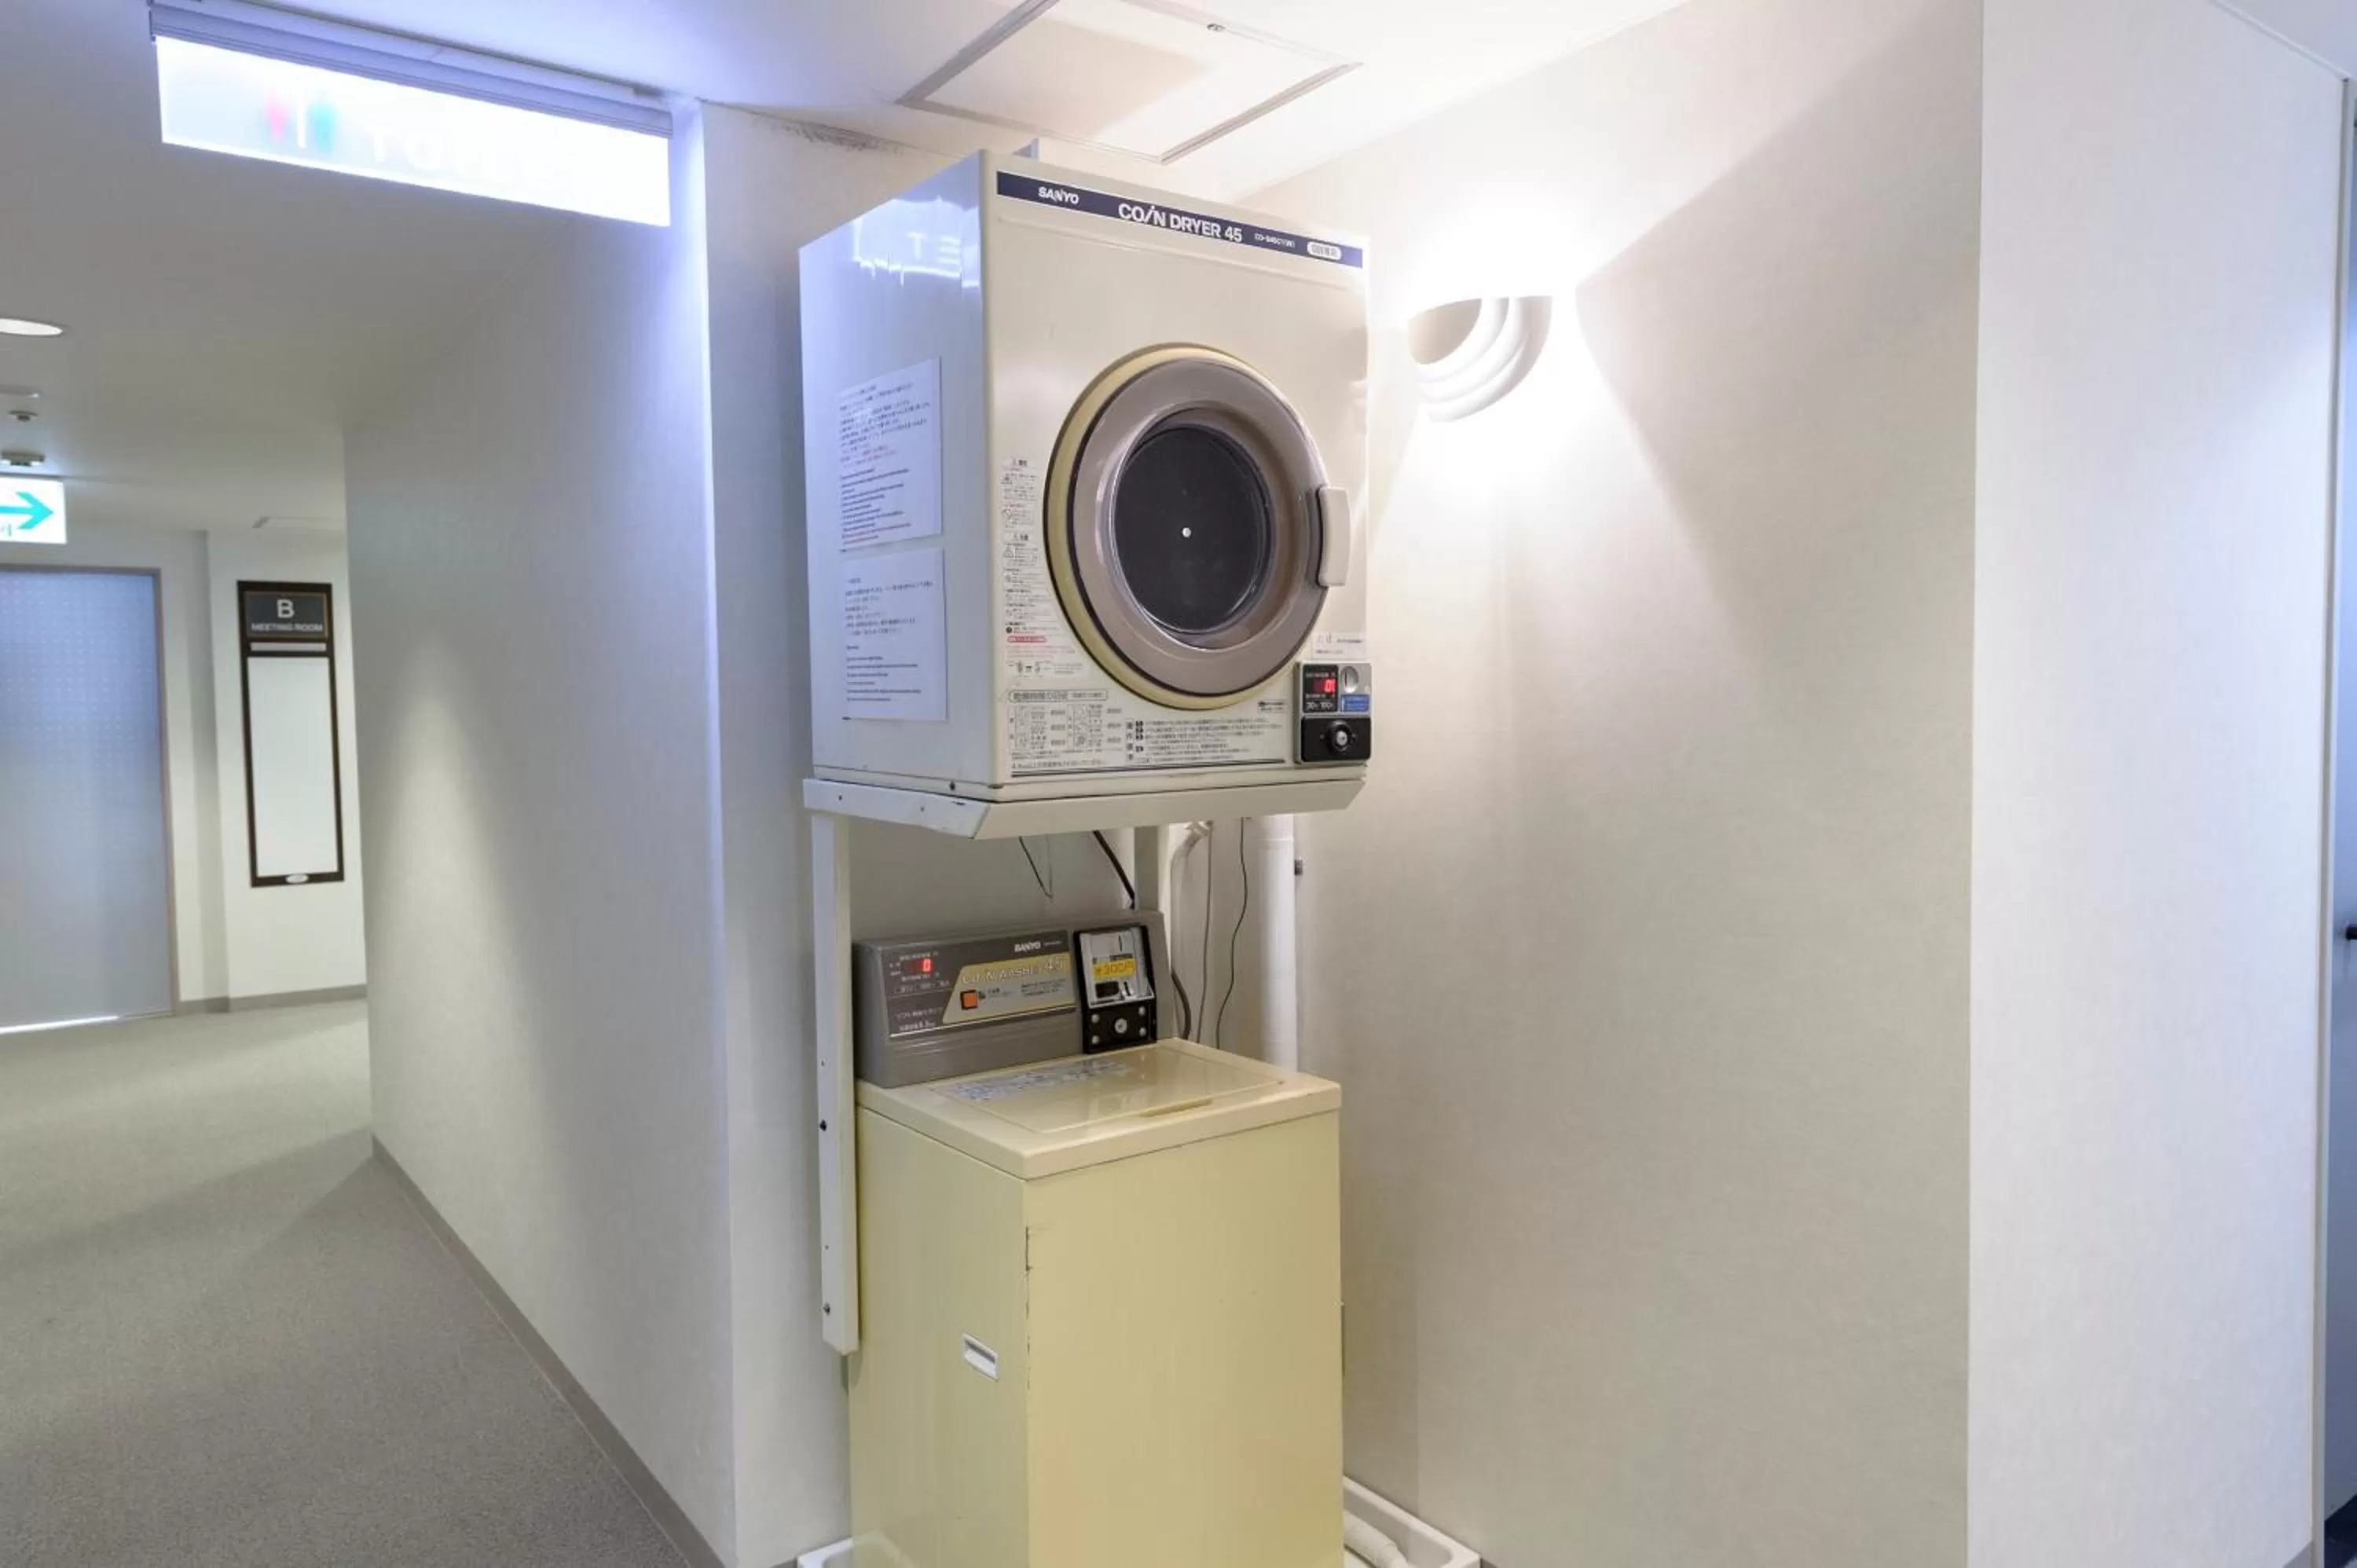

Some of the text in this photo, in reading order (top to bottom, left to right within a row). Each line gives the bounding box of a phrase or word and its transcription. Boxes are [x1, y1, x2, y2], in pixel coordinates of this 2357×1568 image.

[1038, 186, 1080, 204] SANYO
[1169, 213, 1221, 238] DRYER
[1224, 226, 1243, 243] 45
[277, 599, 295, 618] B
[295, 622, 323, 632] ROOM
[1014, 941, 1042, 953] SANYO
